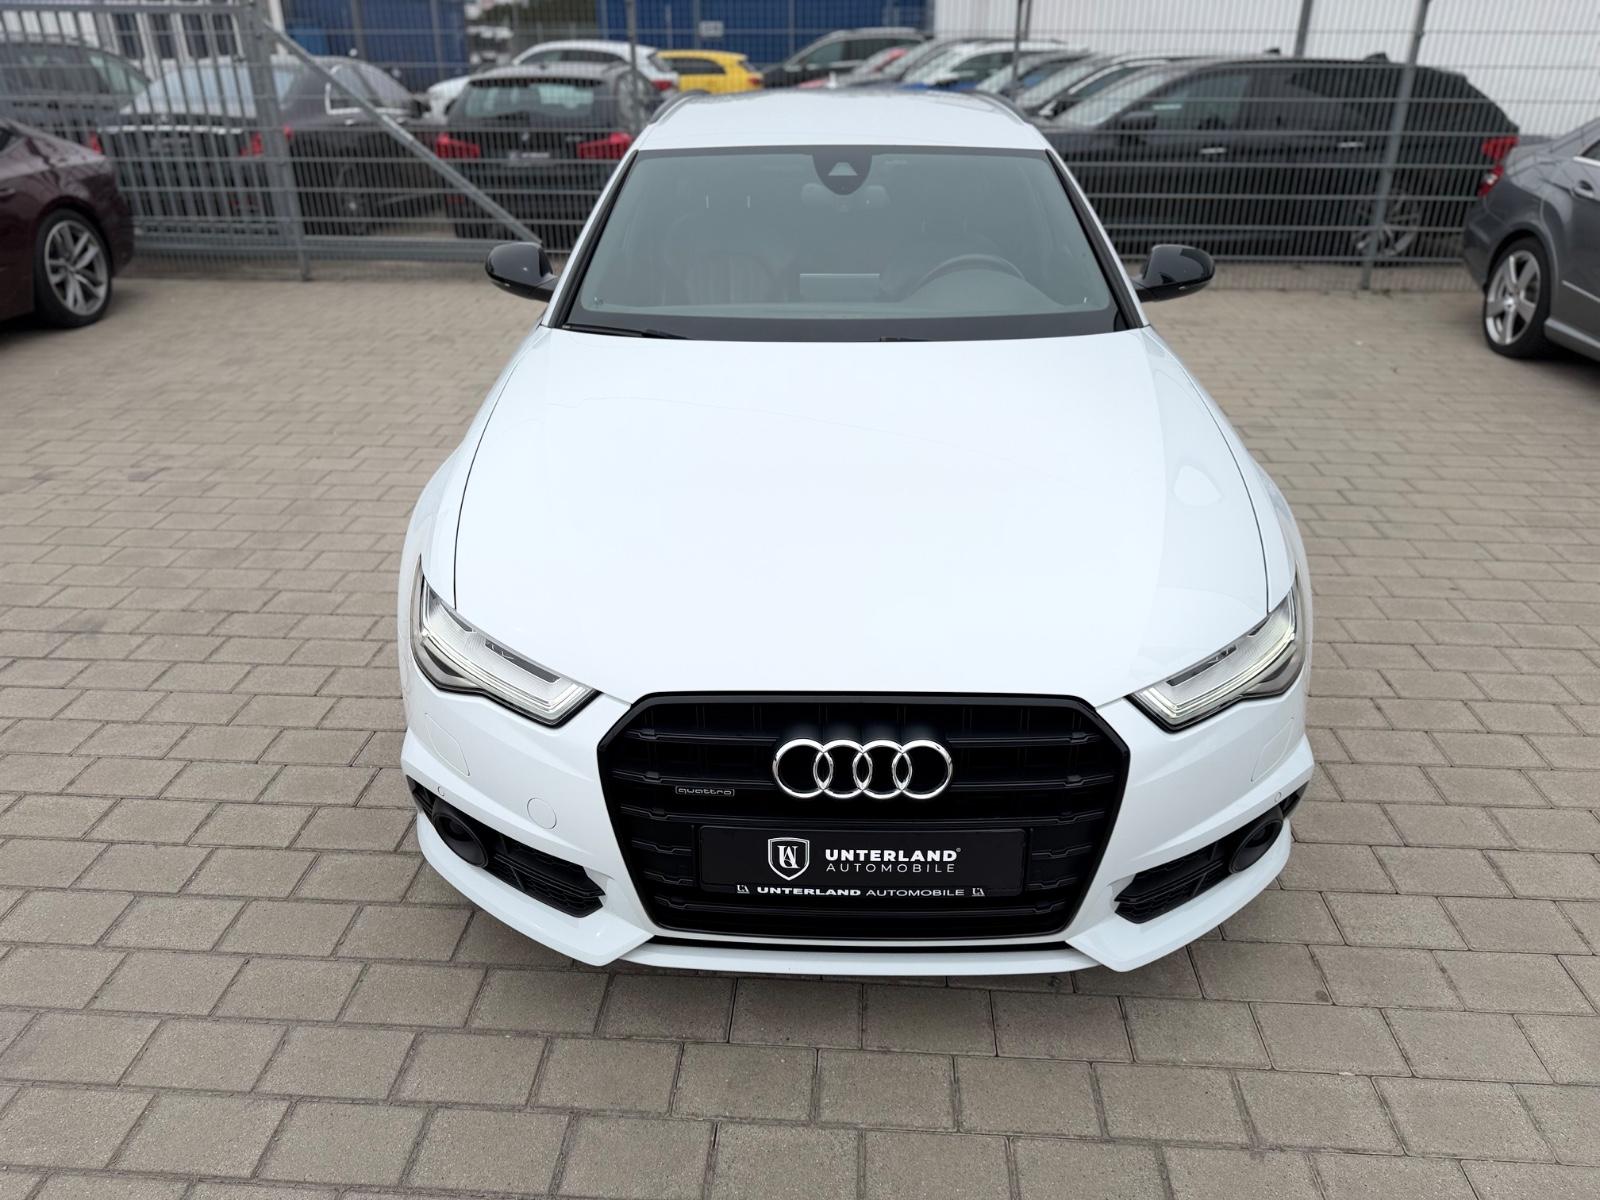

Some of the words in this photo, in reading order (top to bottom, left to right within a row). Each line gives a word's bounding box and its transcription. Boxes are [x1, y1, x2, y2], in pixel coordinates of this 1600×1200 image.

[678, 787, 732, 796] quattro
[825, 849, 957, 863] UNTERLAND
[826, 863, 955, 873] AUTOMOBILE
[756, 886, 861, 896] UNTERLAND
[865, 889, 965, 897] AUTOMOBILE
